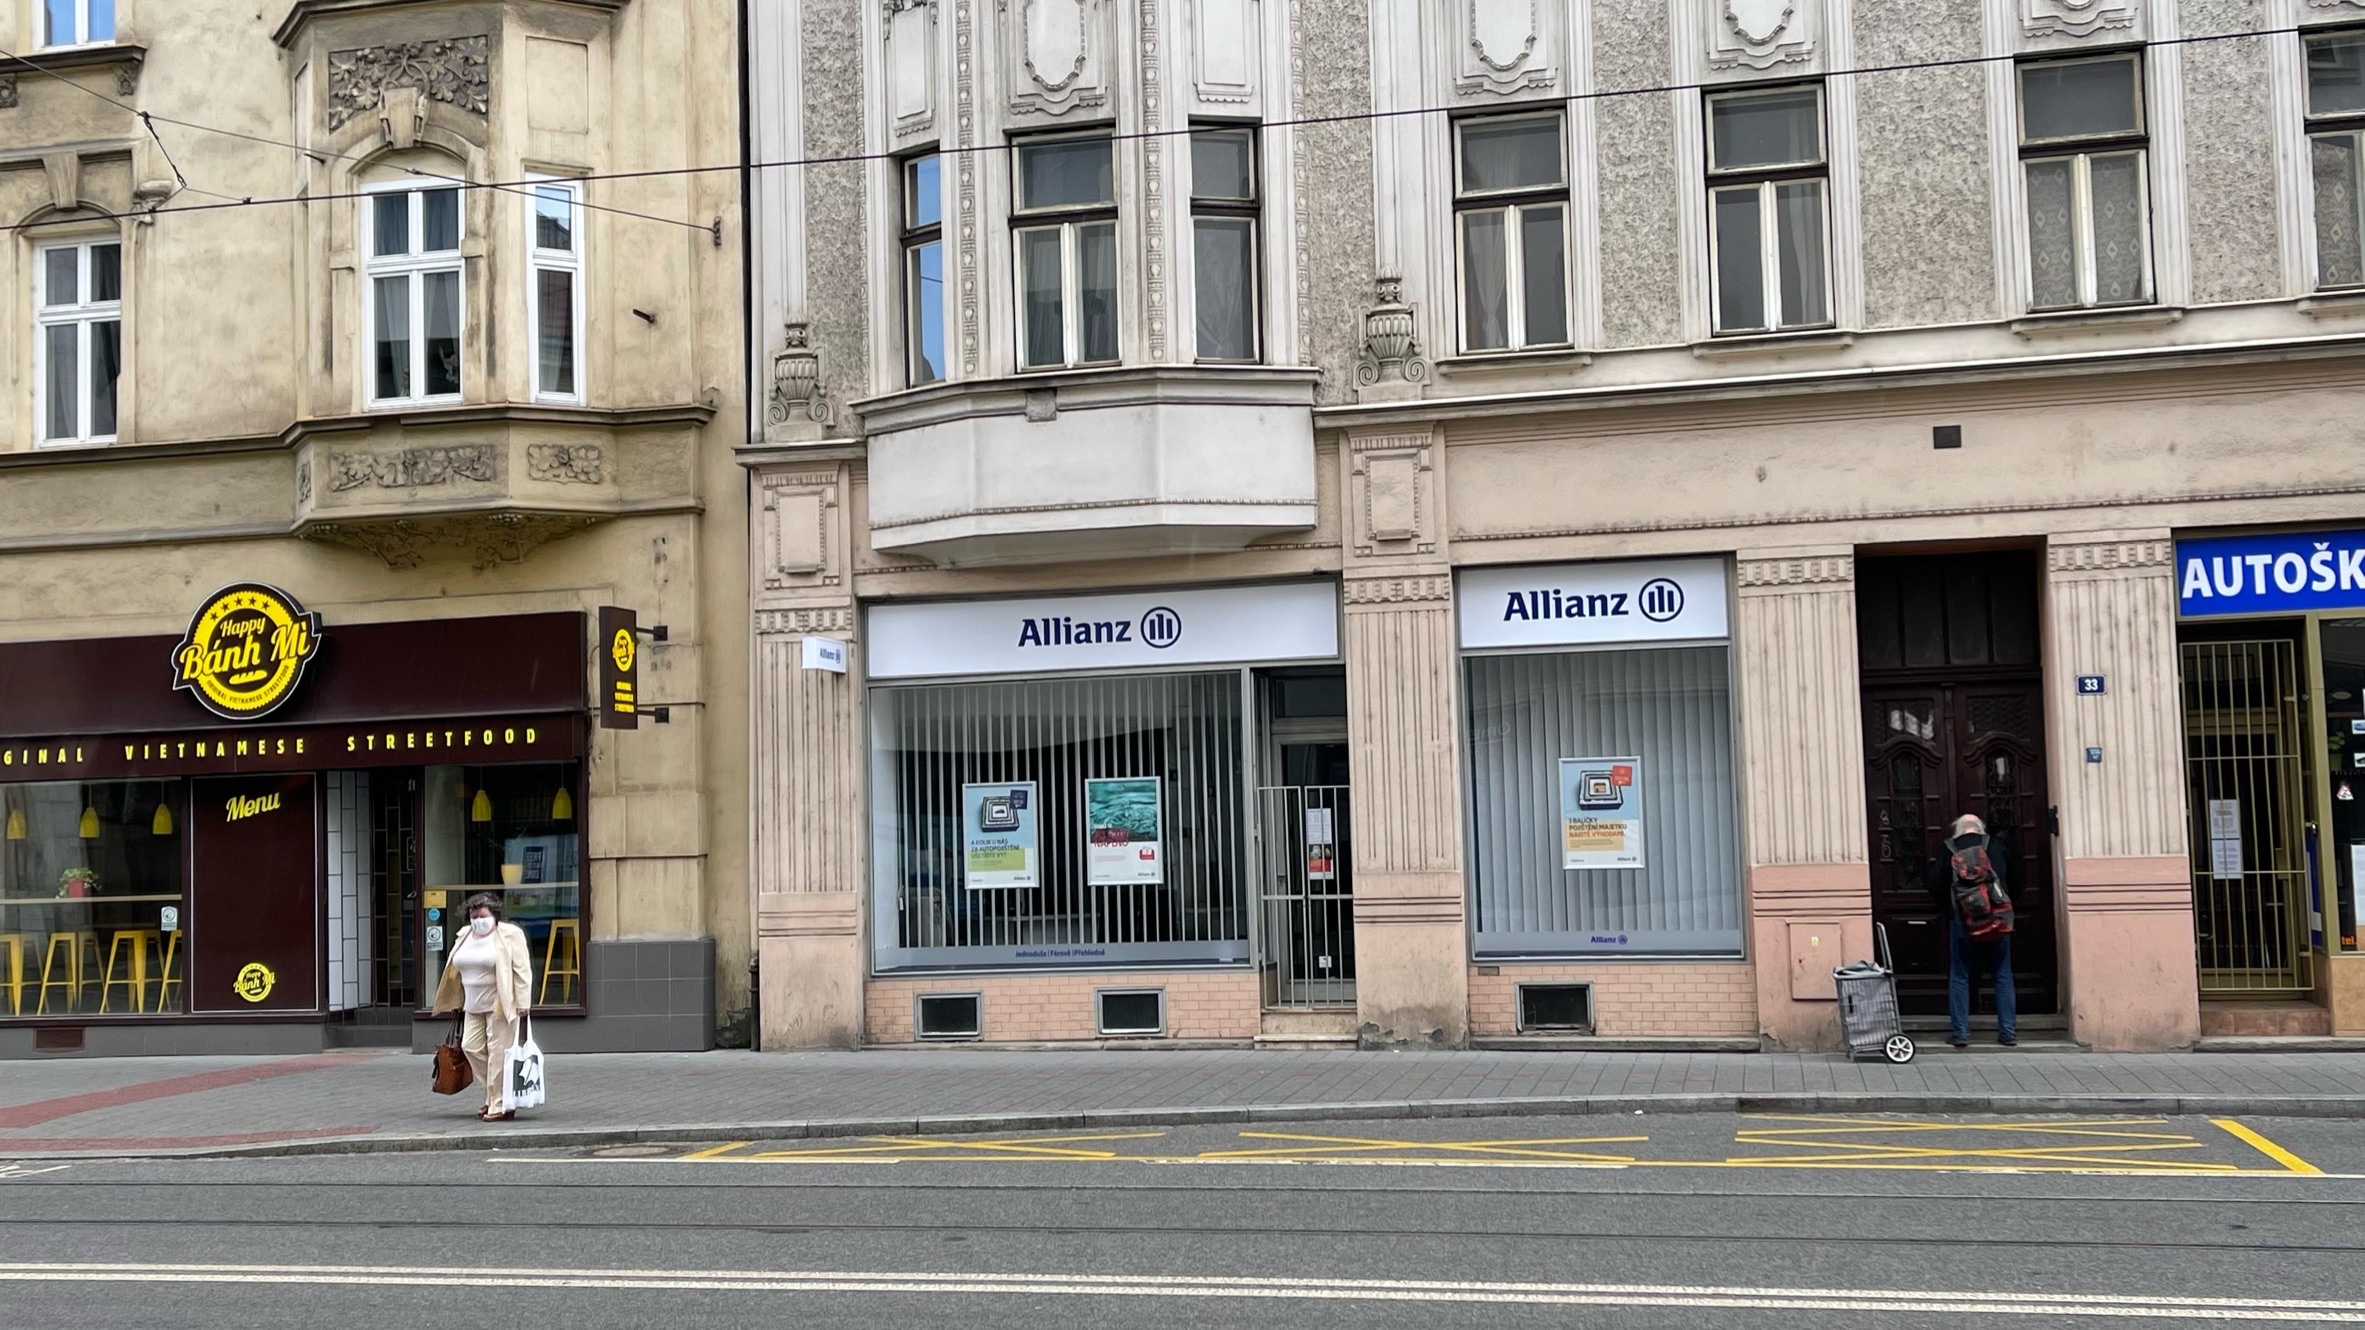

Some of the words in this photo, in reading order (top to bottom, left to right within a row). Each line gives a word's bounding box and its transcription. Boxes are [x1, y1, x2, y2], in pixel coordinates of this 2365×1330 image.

[2181, 541, 2365, 599] AUTOŠK
[1503, 589, 1629, 622] Allianz
[220, 617, 266, 638] Happy
[1018, 616, 1132, 647] Allianz
[179, 635, 261, 681] Bánh
[229, 693, 263, 704] VIETNAMESE
[2084, 678, 2099, 691] 33
[3, 747, 83, 765] GINAL
[125, 738, 304, 761] VIETNAMESE
[347, 728, 536, 752] STREETFOOD
[226, 792, 281, 822] Menu
[1591, 936, 1617, 944] Allianz
